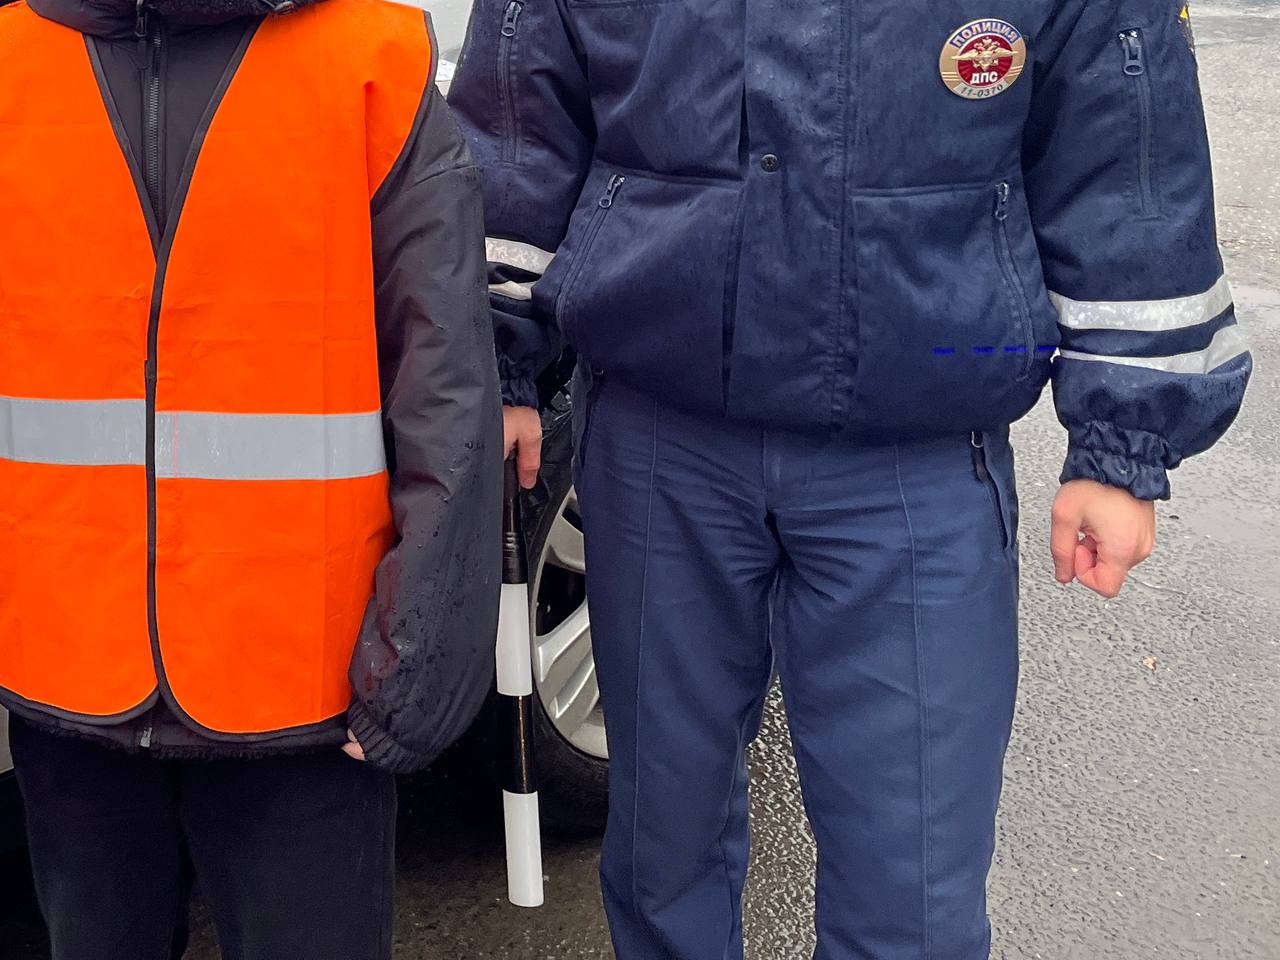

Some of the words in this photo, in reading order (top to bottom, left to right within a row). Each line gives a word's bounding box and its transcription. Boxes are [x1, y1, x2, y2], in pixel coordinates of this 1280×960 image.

[951, 21, 1019, 47] ПОЛИЦИЯ
[970, 71, 999, 85] ДПС
[960, 84, 1004, 98] 11-0370
